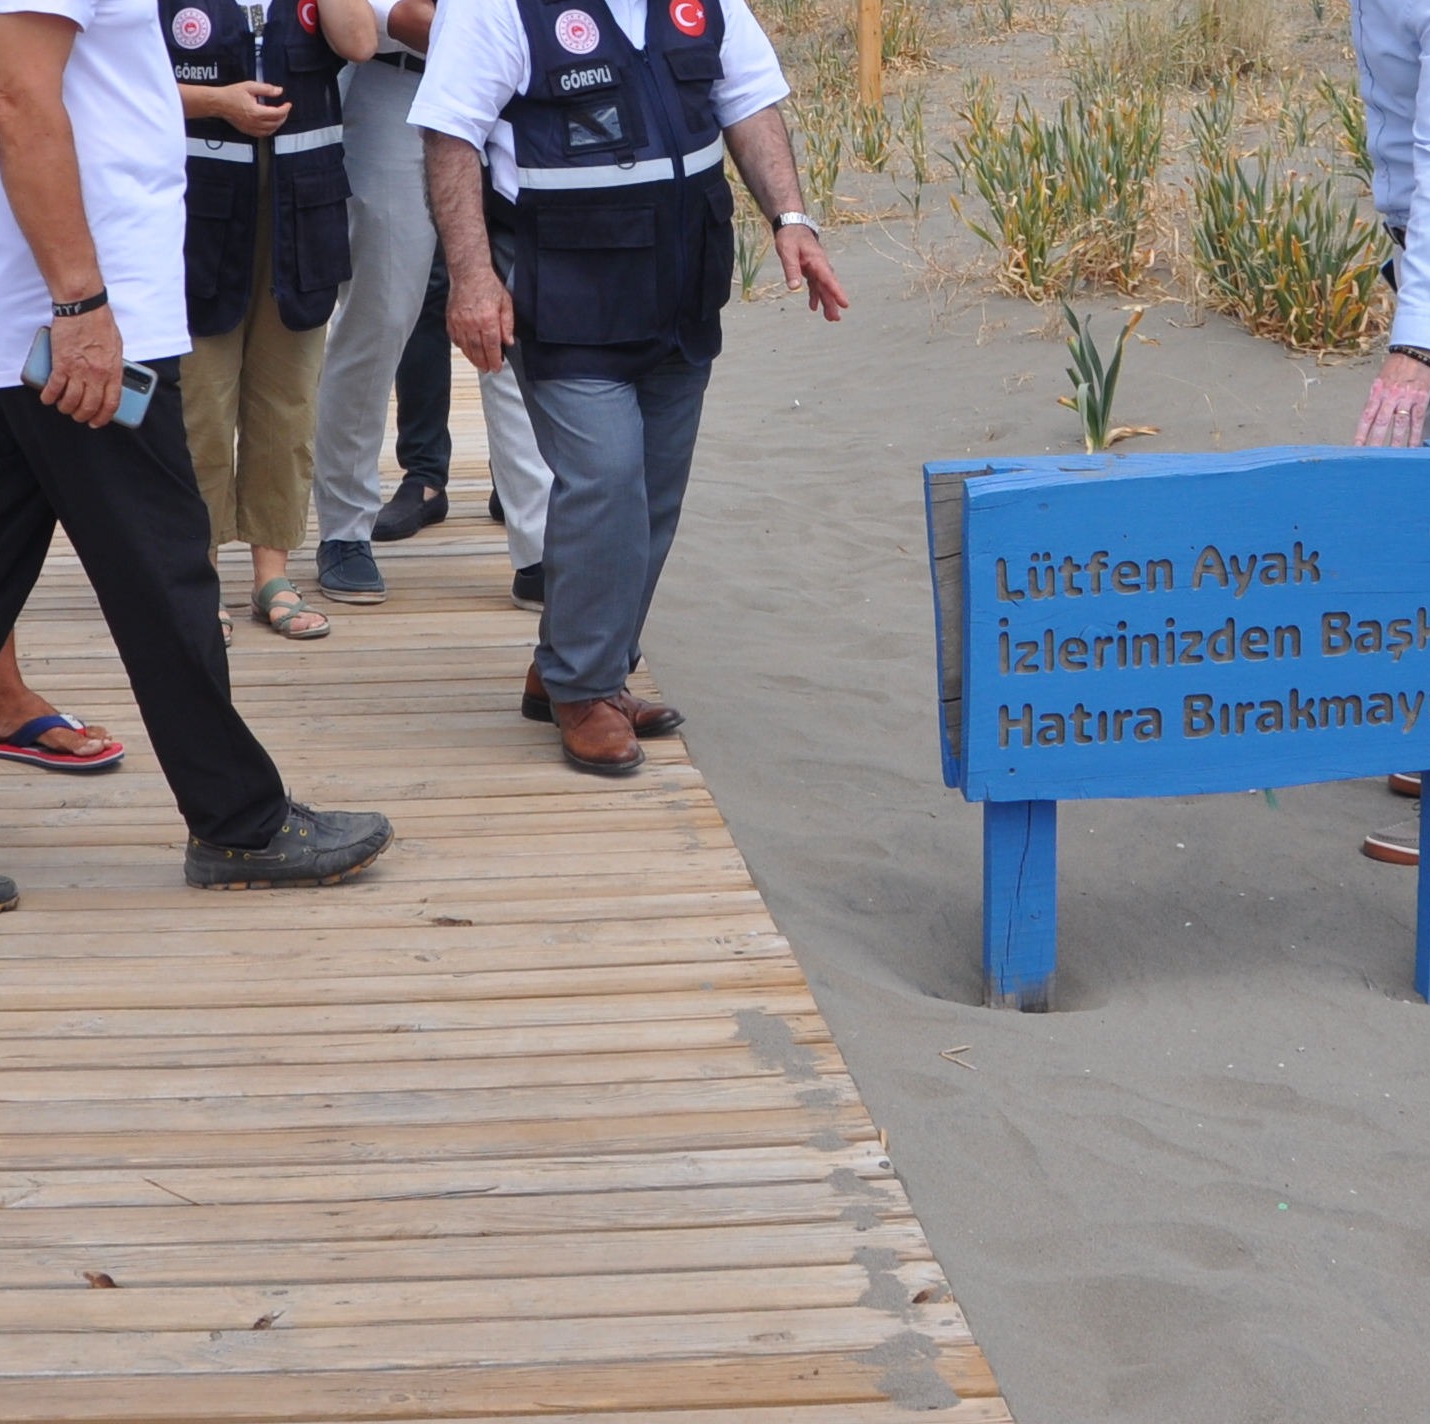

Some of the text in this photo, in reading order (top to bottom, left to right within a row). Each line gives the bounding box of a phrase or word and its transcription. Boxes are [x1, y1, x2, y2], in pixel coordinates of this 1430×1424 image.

[175, 62, 218, 80] GÖREVLİ
[560, 64, 613, 91] GÖREVLİ
[995, 540, 1321, 602] Lütfen Ayak
[998, 616, 1302, 676] İzlerinizden
[998, 702, 1163, 749] Hatıra
